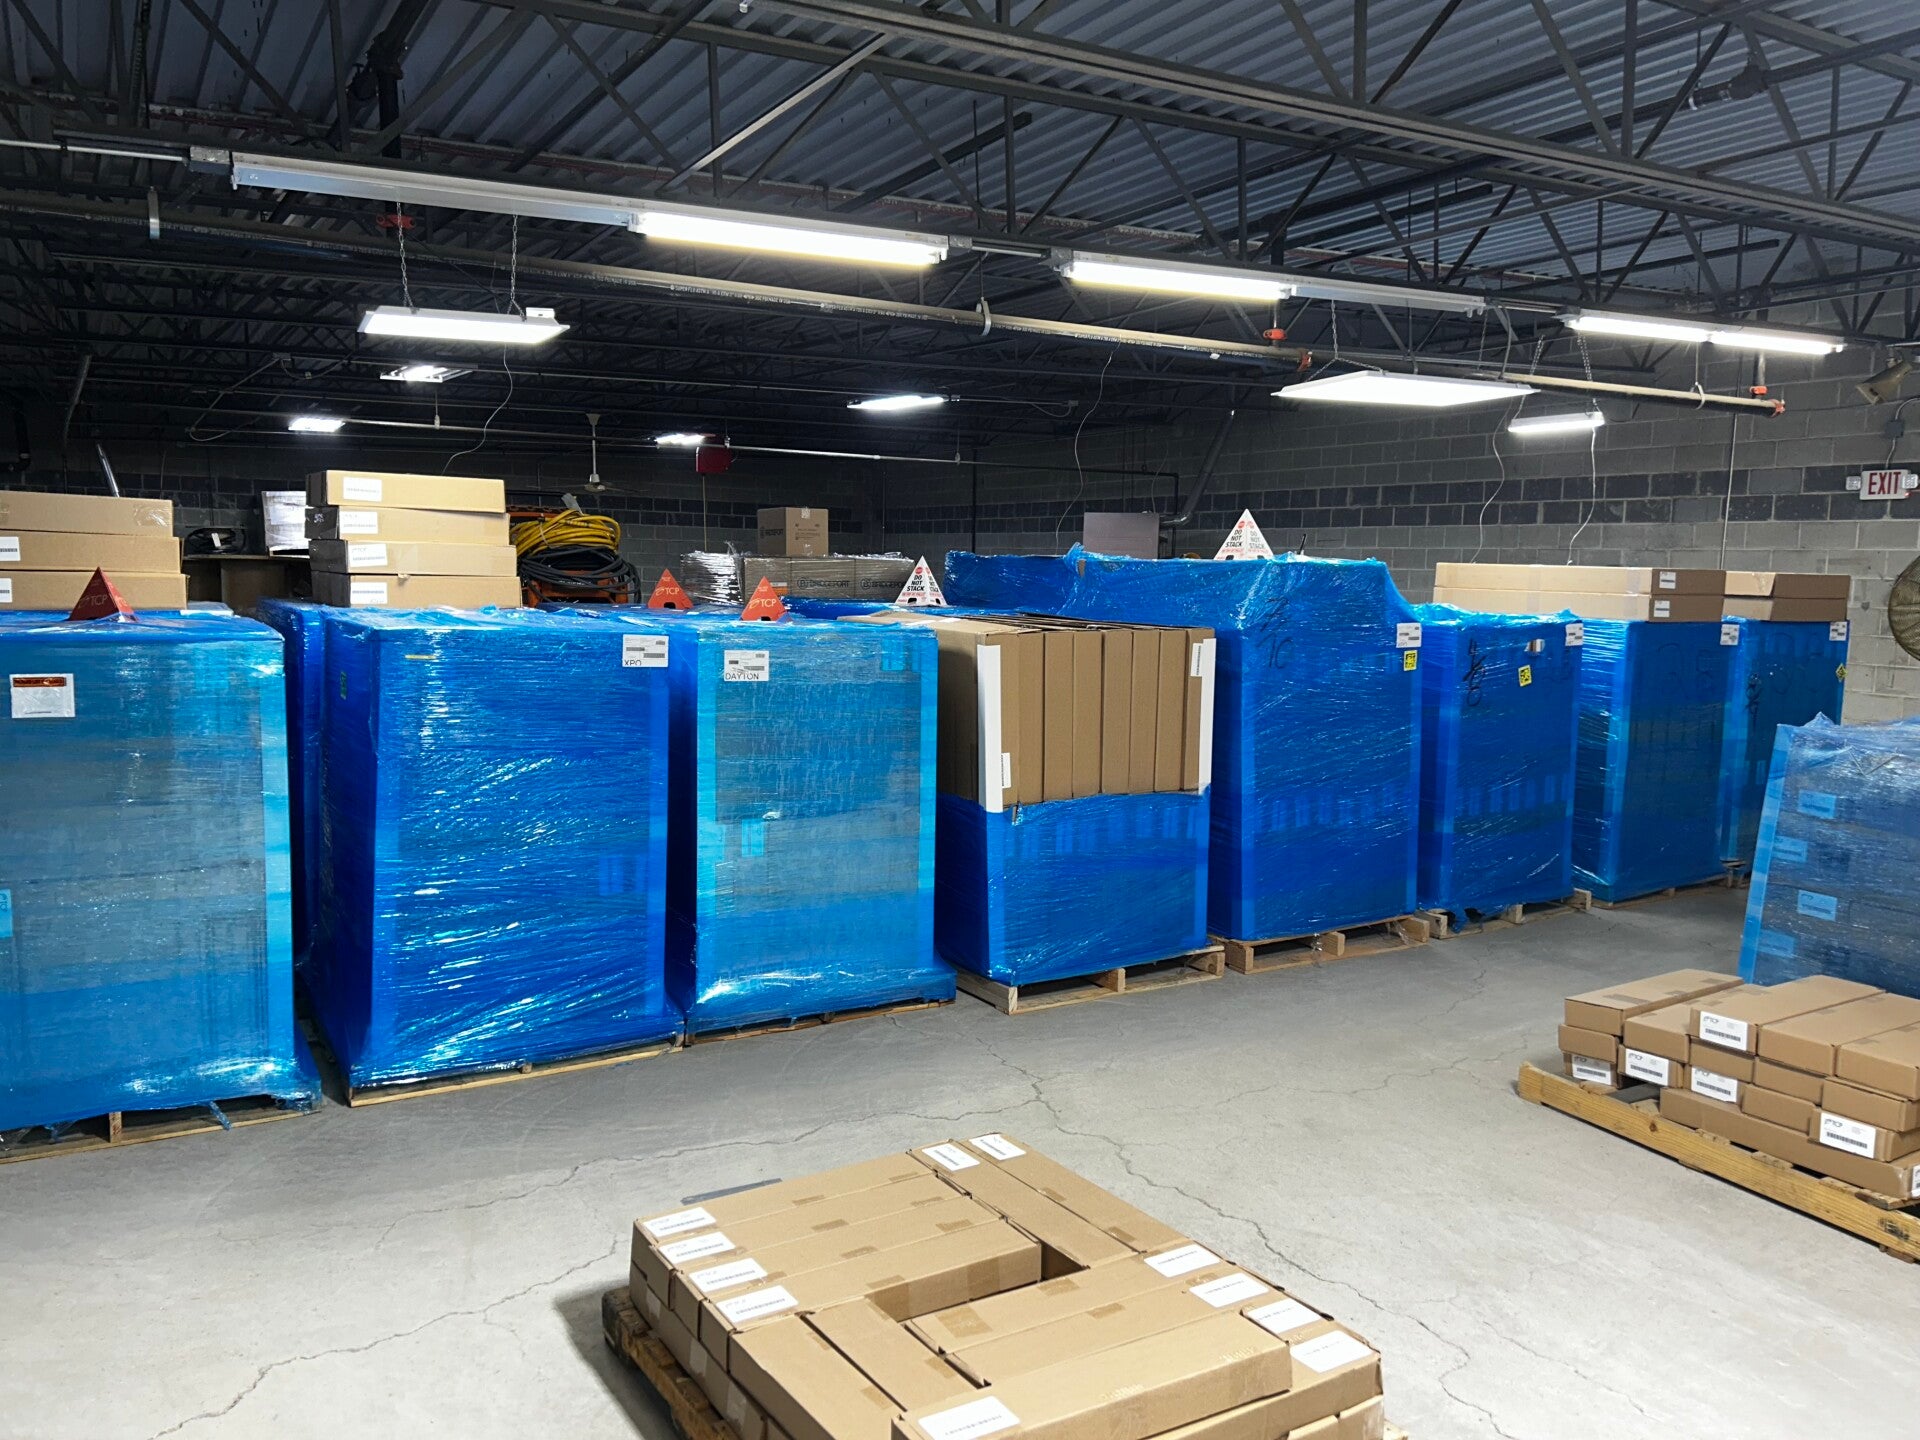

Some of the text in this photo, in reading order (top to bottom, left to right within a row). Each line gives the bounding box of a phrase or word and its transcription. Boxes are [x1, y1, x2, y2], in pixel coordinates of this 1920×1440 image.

[1868, 472, 1901, 495] EXIT
[91, 595, 107, 605] TCP
[761, 599, 776, 607] TCP
[725, 672, 759, 680] DAYTON
